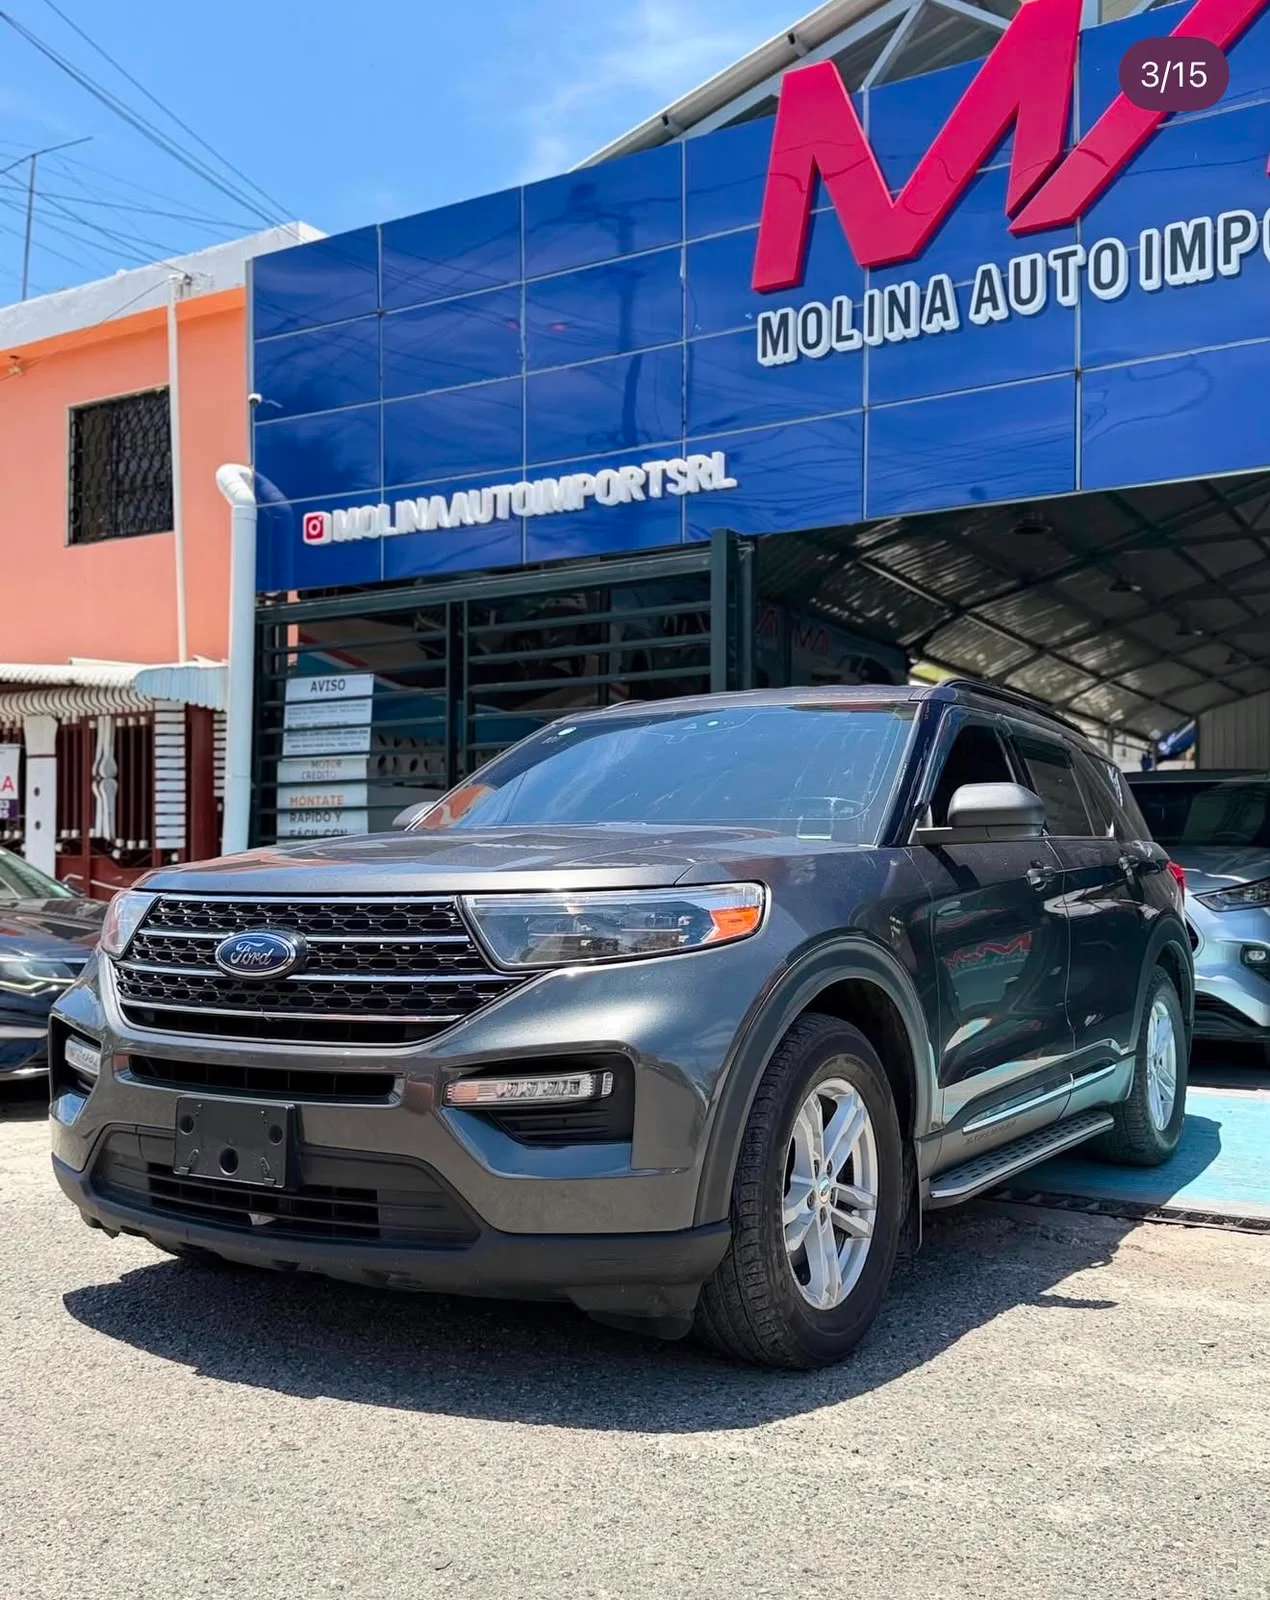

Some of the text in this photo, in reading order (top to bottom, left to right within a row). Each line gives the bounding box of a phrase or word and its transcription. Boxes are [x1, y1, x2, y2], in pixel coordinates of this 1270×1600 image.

[757, 207, 1270, 368] MOLINA AUTO IMP
[332, 451, 738, 542] MOLINAAUTOIMPORTSRL
[310, 678, 346, 693] AVISO
[230, 940, 275, 966] Ford
